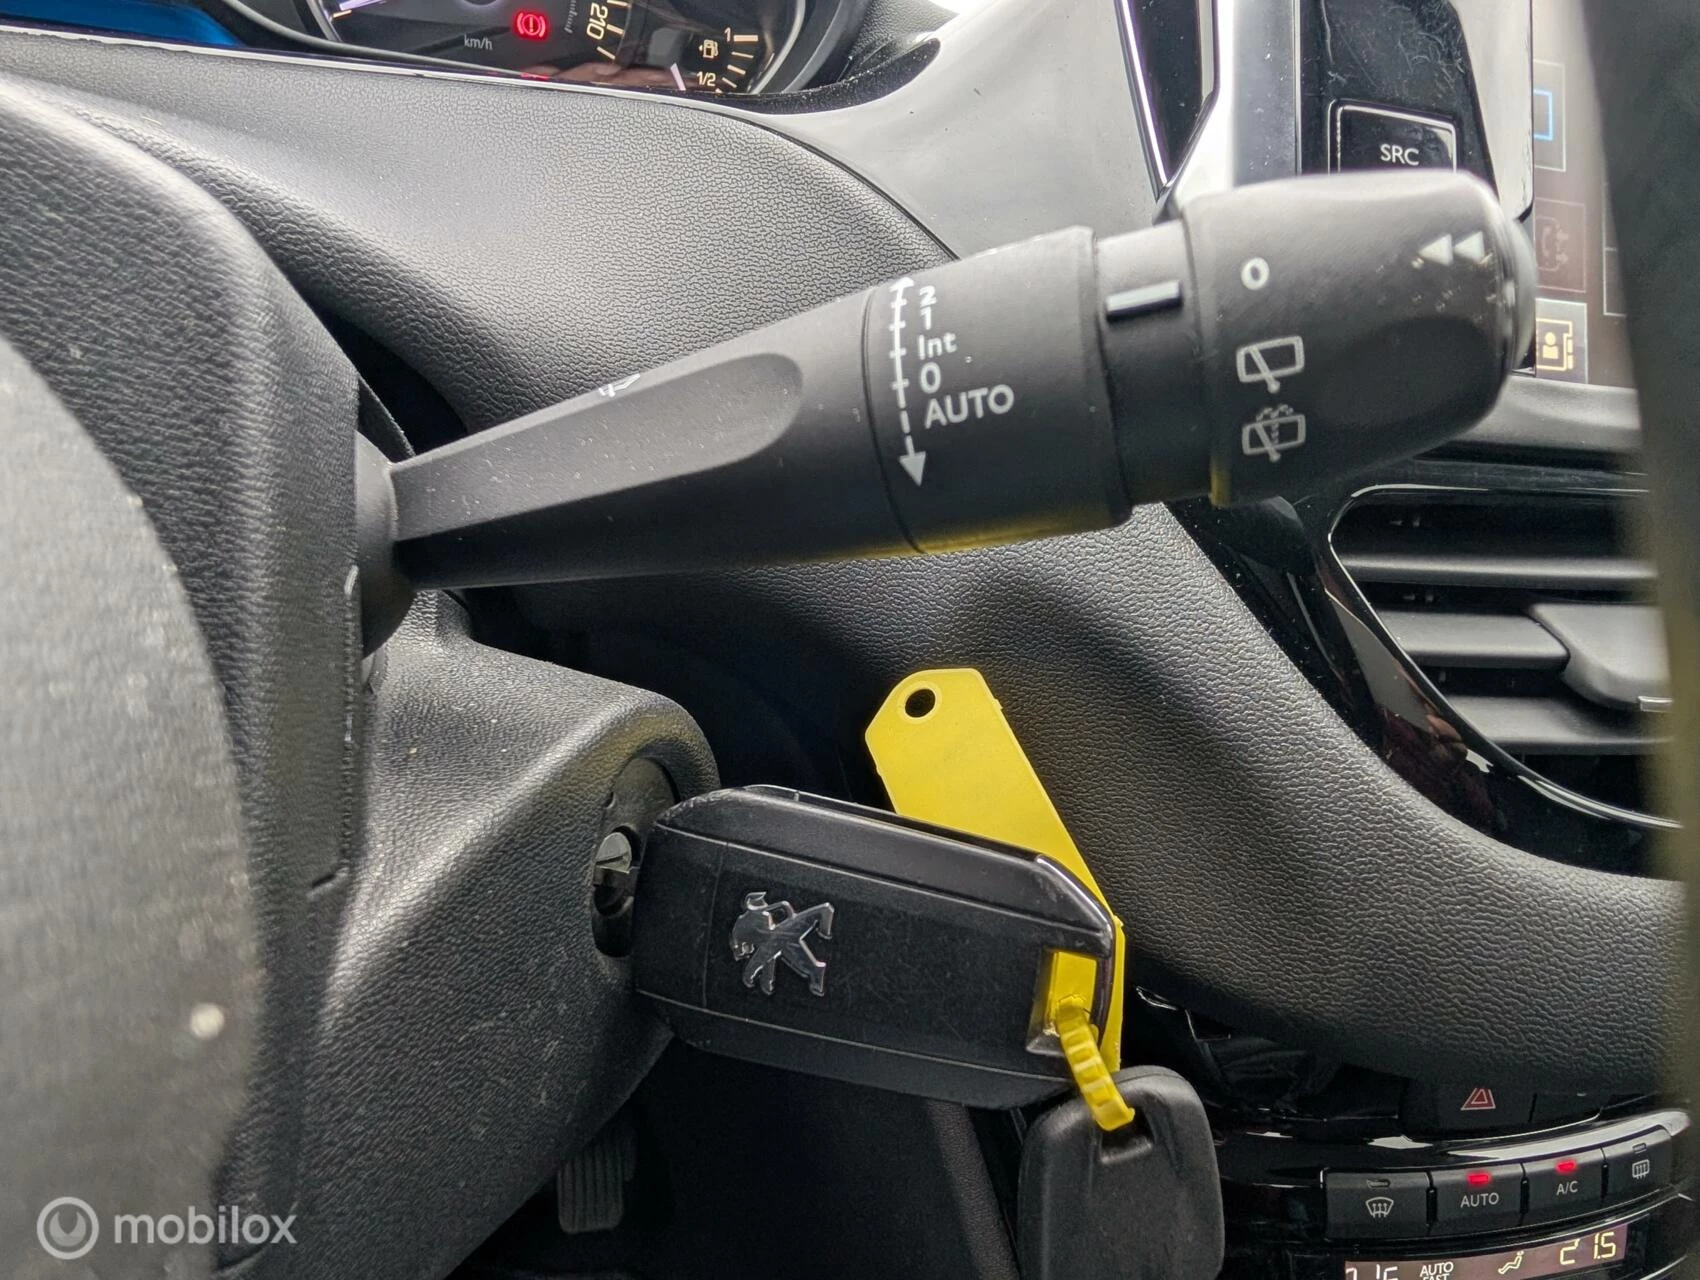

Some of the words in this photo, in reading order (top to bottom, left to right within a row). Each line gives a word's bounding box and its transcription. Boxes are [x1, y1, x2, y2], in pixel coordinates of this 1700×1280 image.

[587, 2, 608, 40] 210
[463, 33, 493, 50] km/h
[724, 27, 732, 42] 1
[697, 71, 717, 87] 1/2
[1380, 143, 1420, 166] SRC
[918, 285, 937, 306] 2
[920, 306, 932, 330] 1
[917, 332, 957, 360] Int
[924, 385, 1014, 429] AUTO
[1556, 1180, 1578, 1196] A/C
[1460, 1192, 1500, 1208] AUTO
[1419, 1261, 1454, 1278] AUTO
